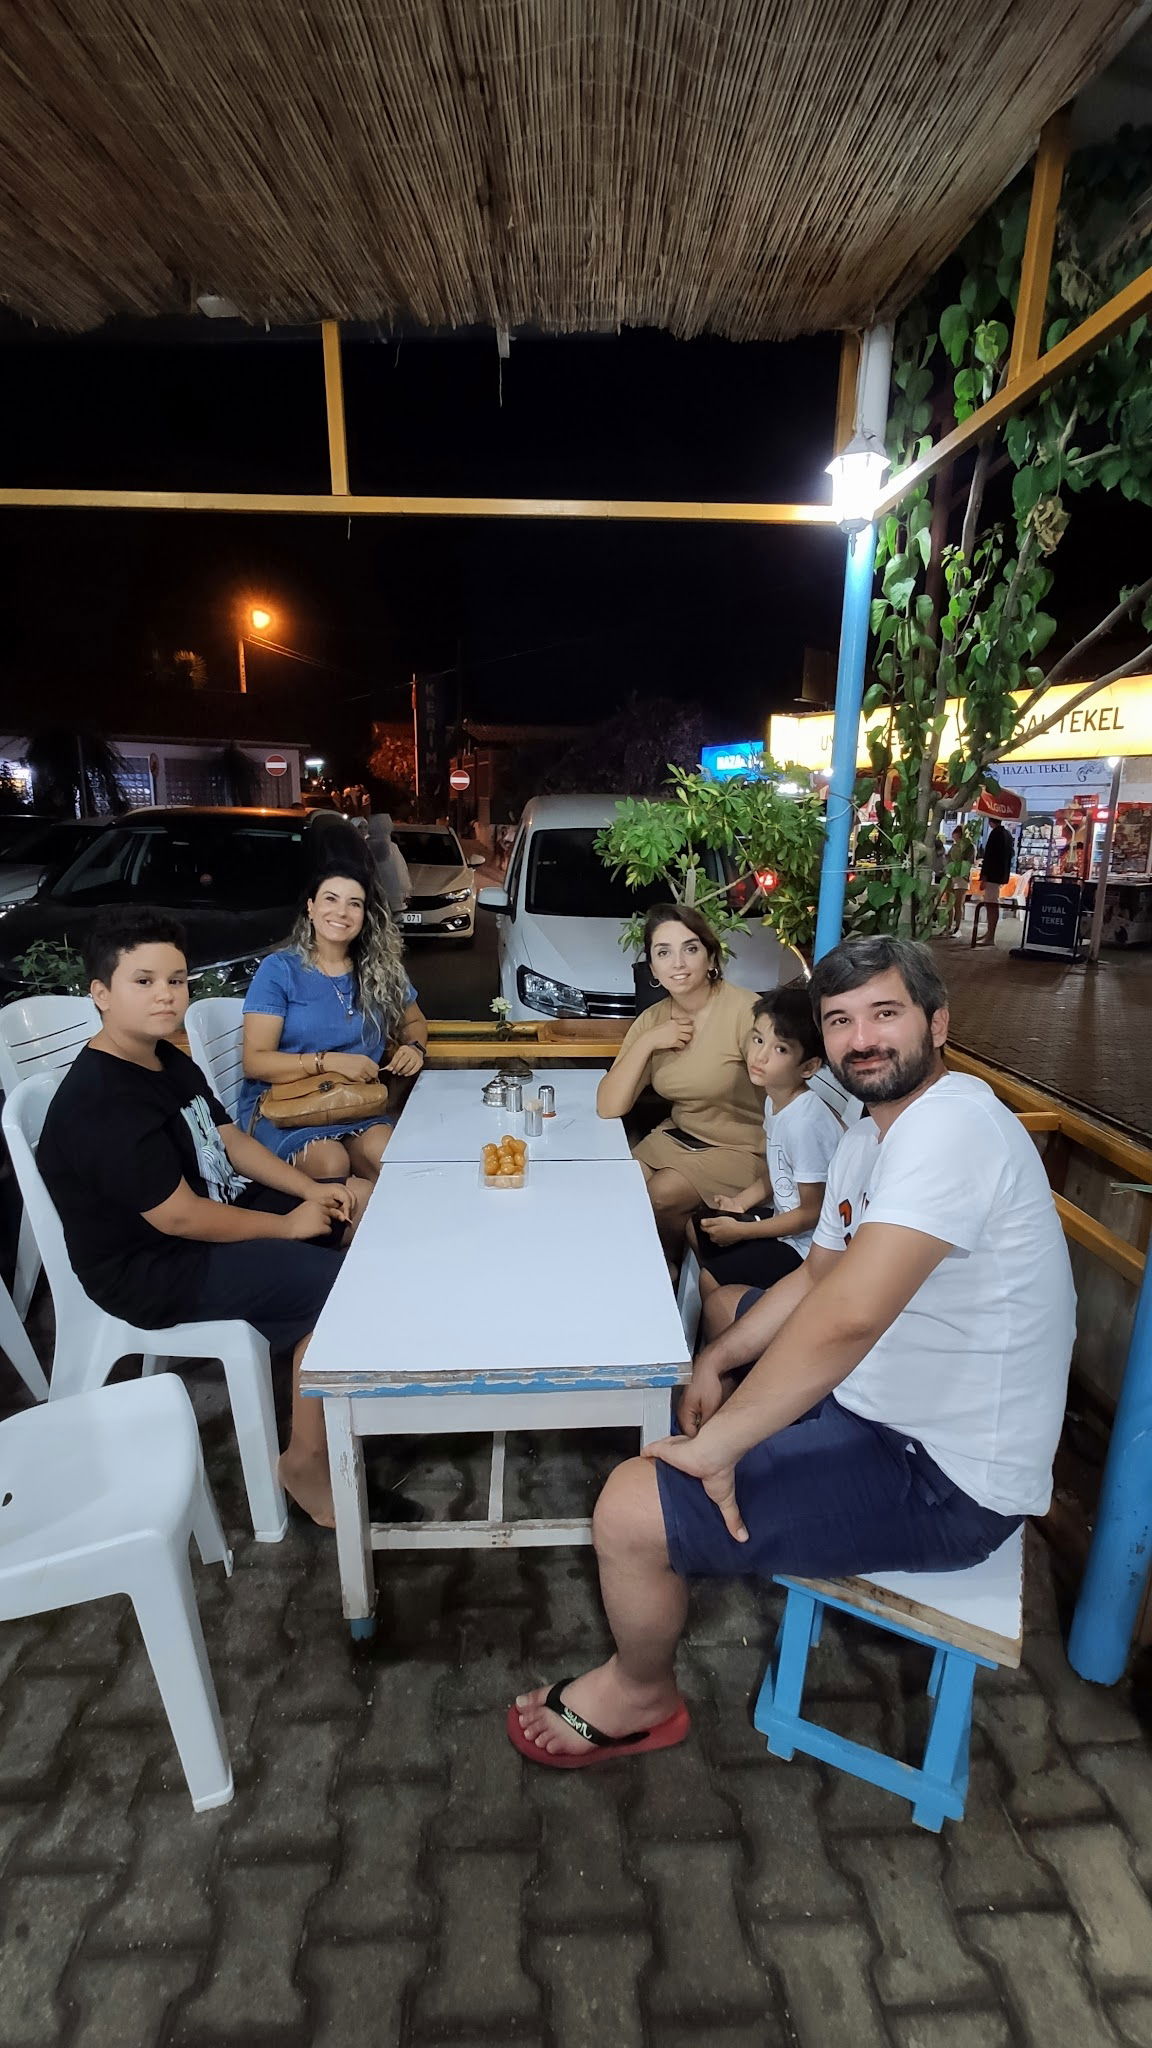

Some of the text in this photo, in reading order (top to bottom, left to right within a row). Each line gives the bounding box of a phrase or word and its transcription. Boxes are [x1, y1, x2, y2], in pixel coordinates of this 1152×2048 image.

[1060, 707, 1125, 734] TEKEL
[1002, 763, 1072, 775] HAZAL TEKEL
[1041, 905, 1066, 914] UYSAL
[406, 914, 420, 922] 071
[1040, 916, 1064, 925] TEKEL
